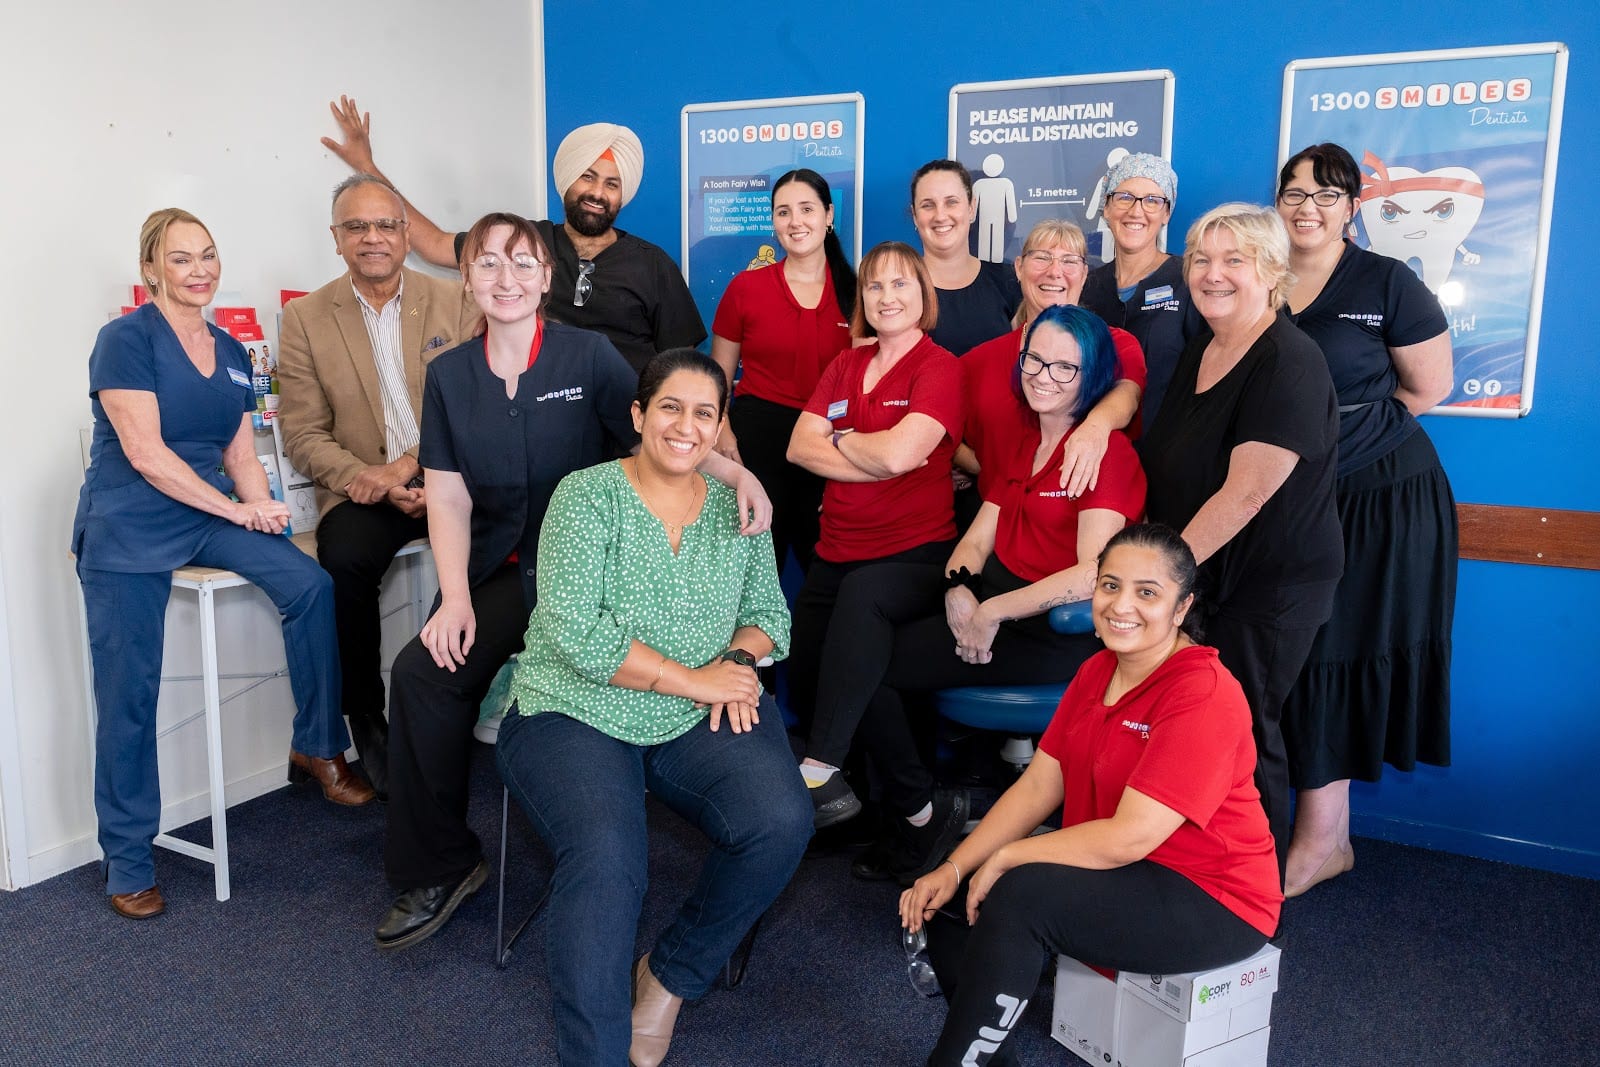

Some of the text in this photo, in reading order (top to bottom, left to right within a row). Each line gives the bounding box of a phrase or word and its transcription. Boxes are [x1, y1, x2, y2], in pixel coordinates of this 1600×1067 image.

[1310, 81, 1529, 112] 1300 SMILES
[969, 102, 1114, 126] PLEASE MAINTAIN
[1468, 107, 1529, 126] Dentists
[700, 122, 841, 144] 1300 SMILES
[969, 120, 1138, 145] SOCIAL DISTANCING
[804, 142, 842, 157] Dentists
[711, 181, 729, 189] Tooth
[731, 180, 748, 189] Fairy
[750, 179, 766, 187] Wish
[1028, 187, 1078, 197] 1.5 metres
[736, 196, 747, 204] lost
[740, 205, 755, 214] Fairy
[709, 215, 723, 223] Your
[725, 215, 747, 224] missing
[749, 214, 765, 222] tooth
[722, 224, 744, 232] replace
[746, 223, 759, 231] with
[1259, 966, 1267, 974] A4
[1240, 971, 1255, 986] 80
[1208, 980, 1232, 997] COPY
